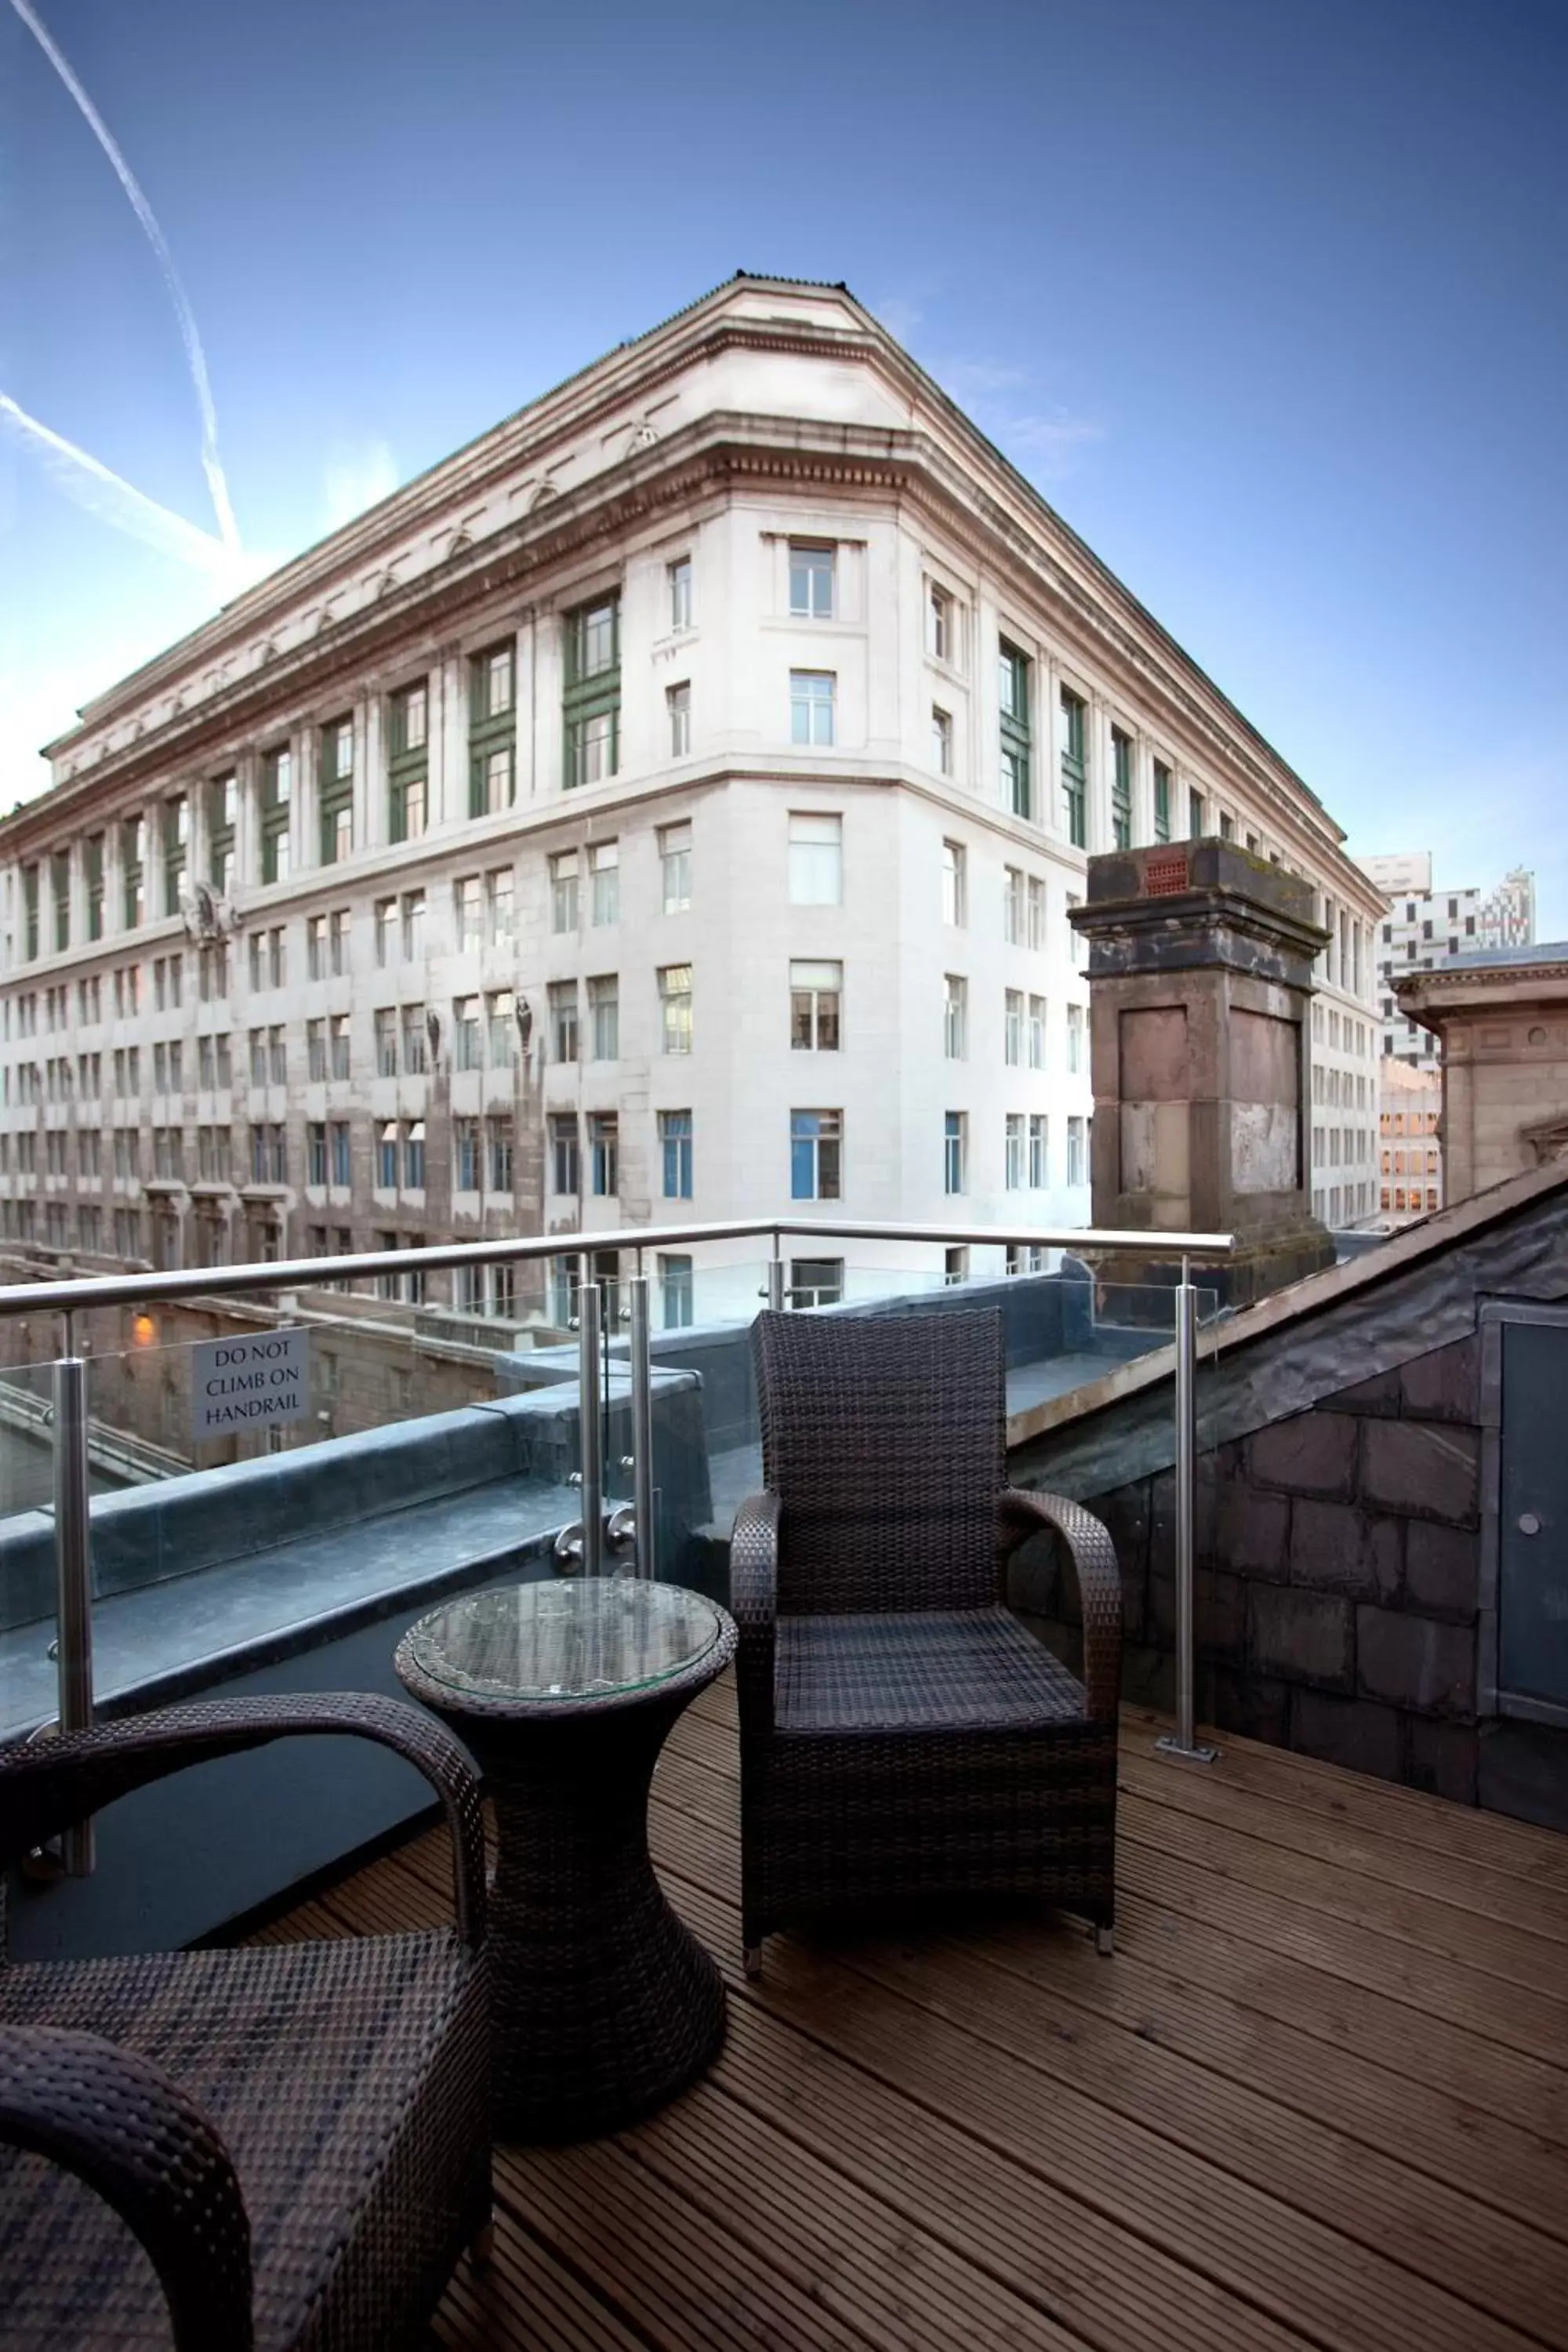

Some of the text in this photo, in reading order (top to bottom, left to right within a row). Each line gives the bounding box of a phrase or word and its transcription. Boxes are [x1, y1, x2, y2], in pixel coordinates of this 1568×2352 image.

[215, 1340, 291, 1367] DO NOT
[206, 1367, 299, 1396] CLIMB ON
[206, 1392, 299, 1425] HANDRAIL
